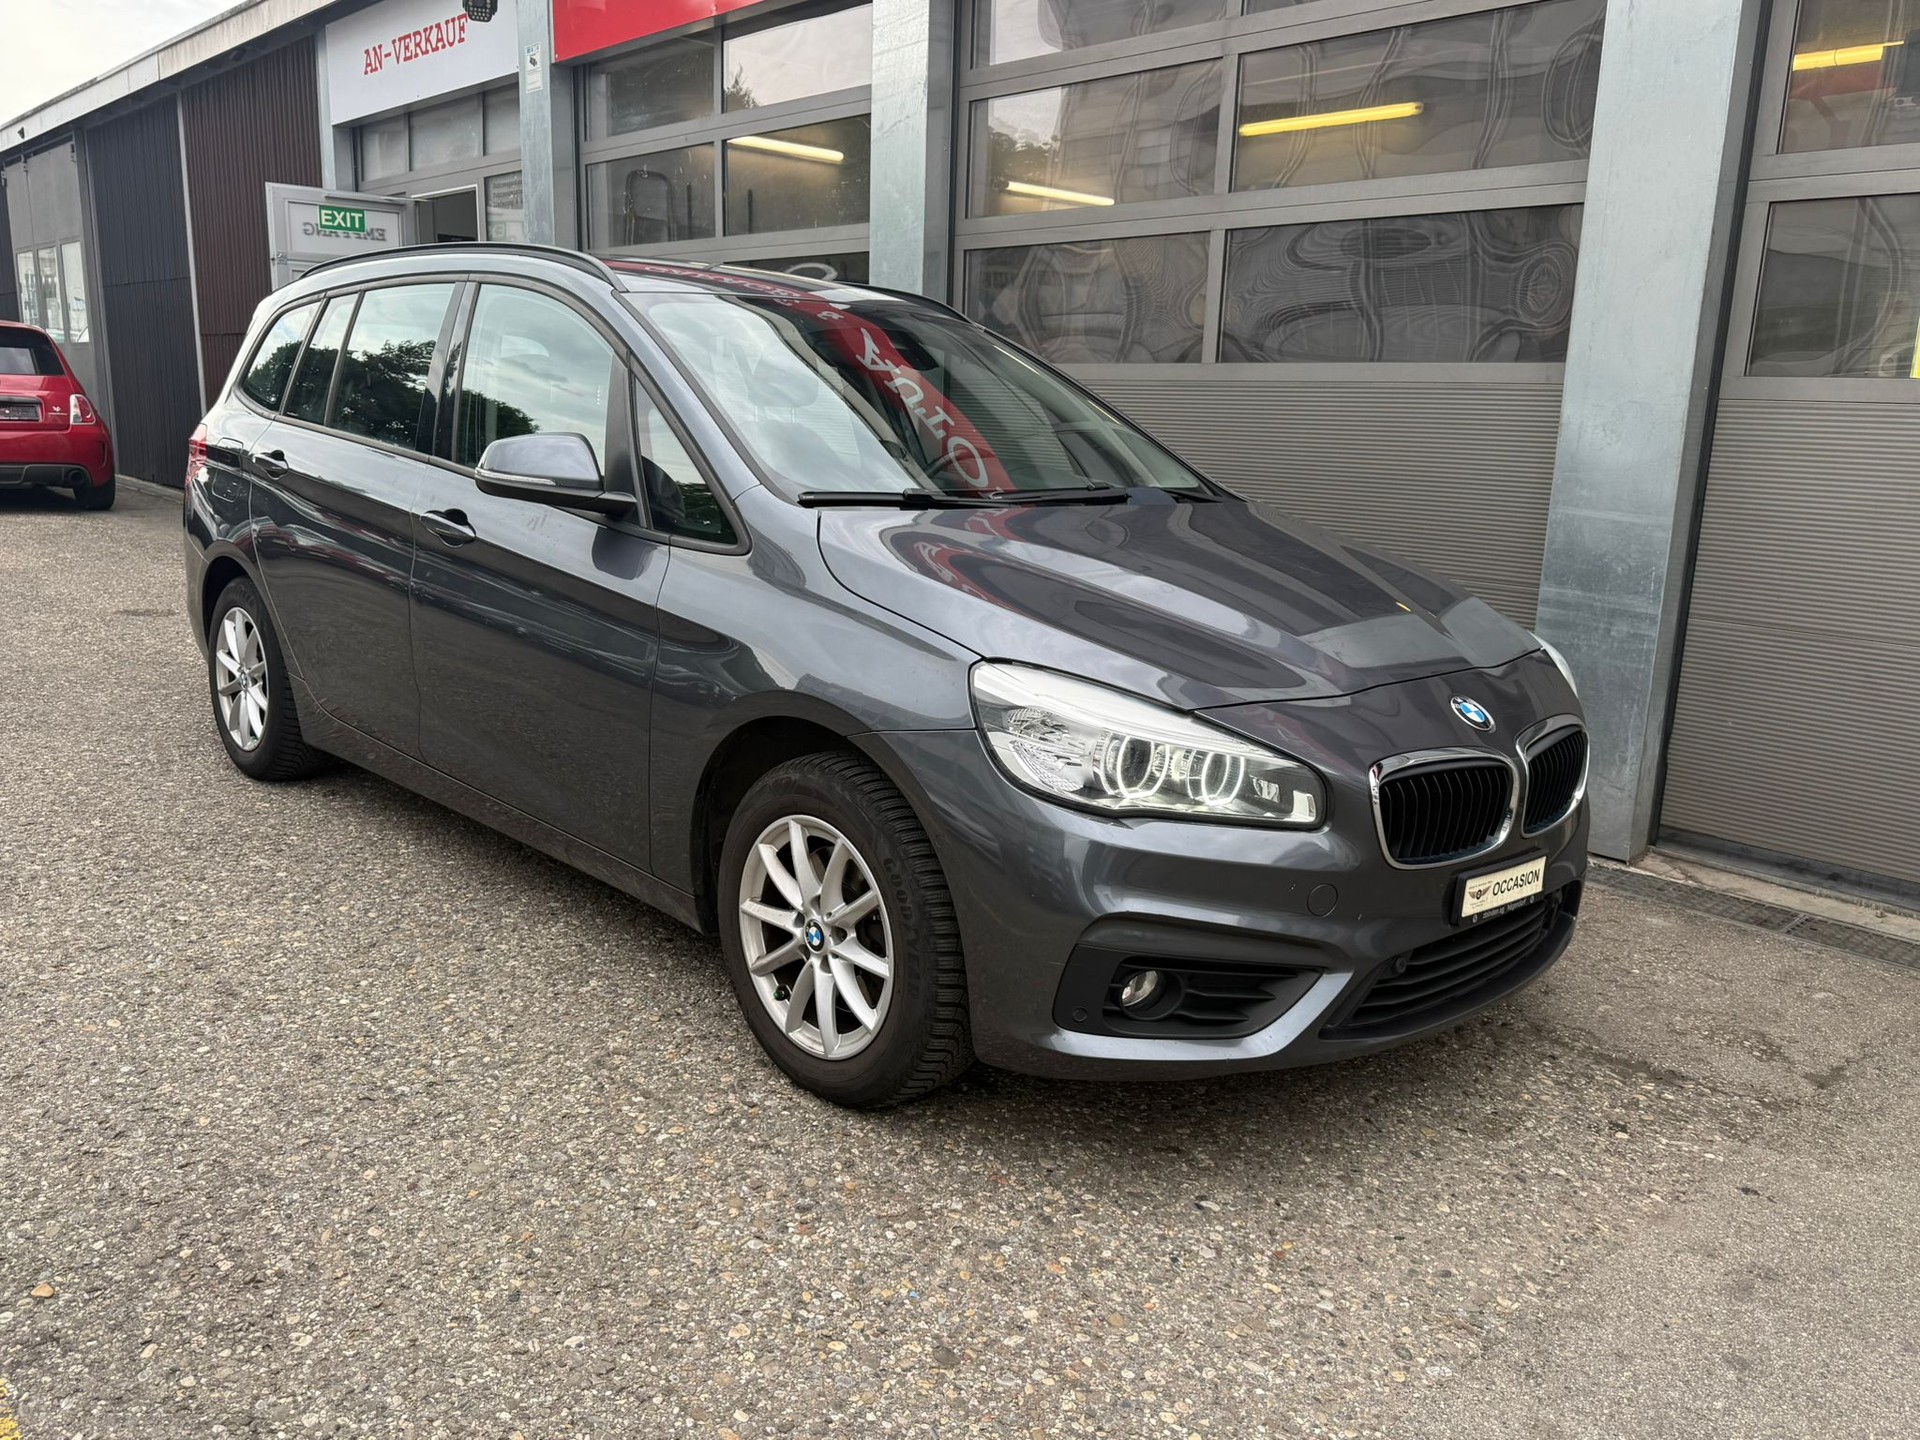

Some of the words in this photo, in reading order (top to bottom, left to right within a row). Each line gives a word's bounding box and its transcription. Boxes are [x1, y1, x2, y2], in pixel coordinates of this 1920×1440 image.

[364, 13, 468, 75] AN-VERKAUF
[320, 209, 363, 229] EXIT
[1492, 868, 1541, 896] OCCASION
